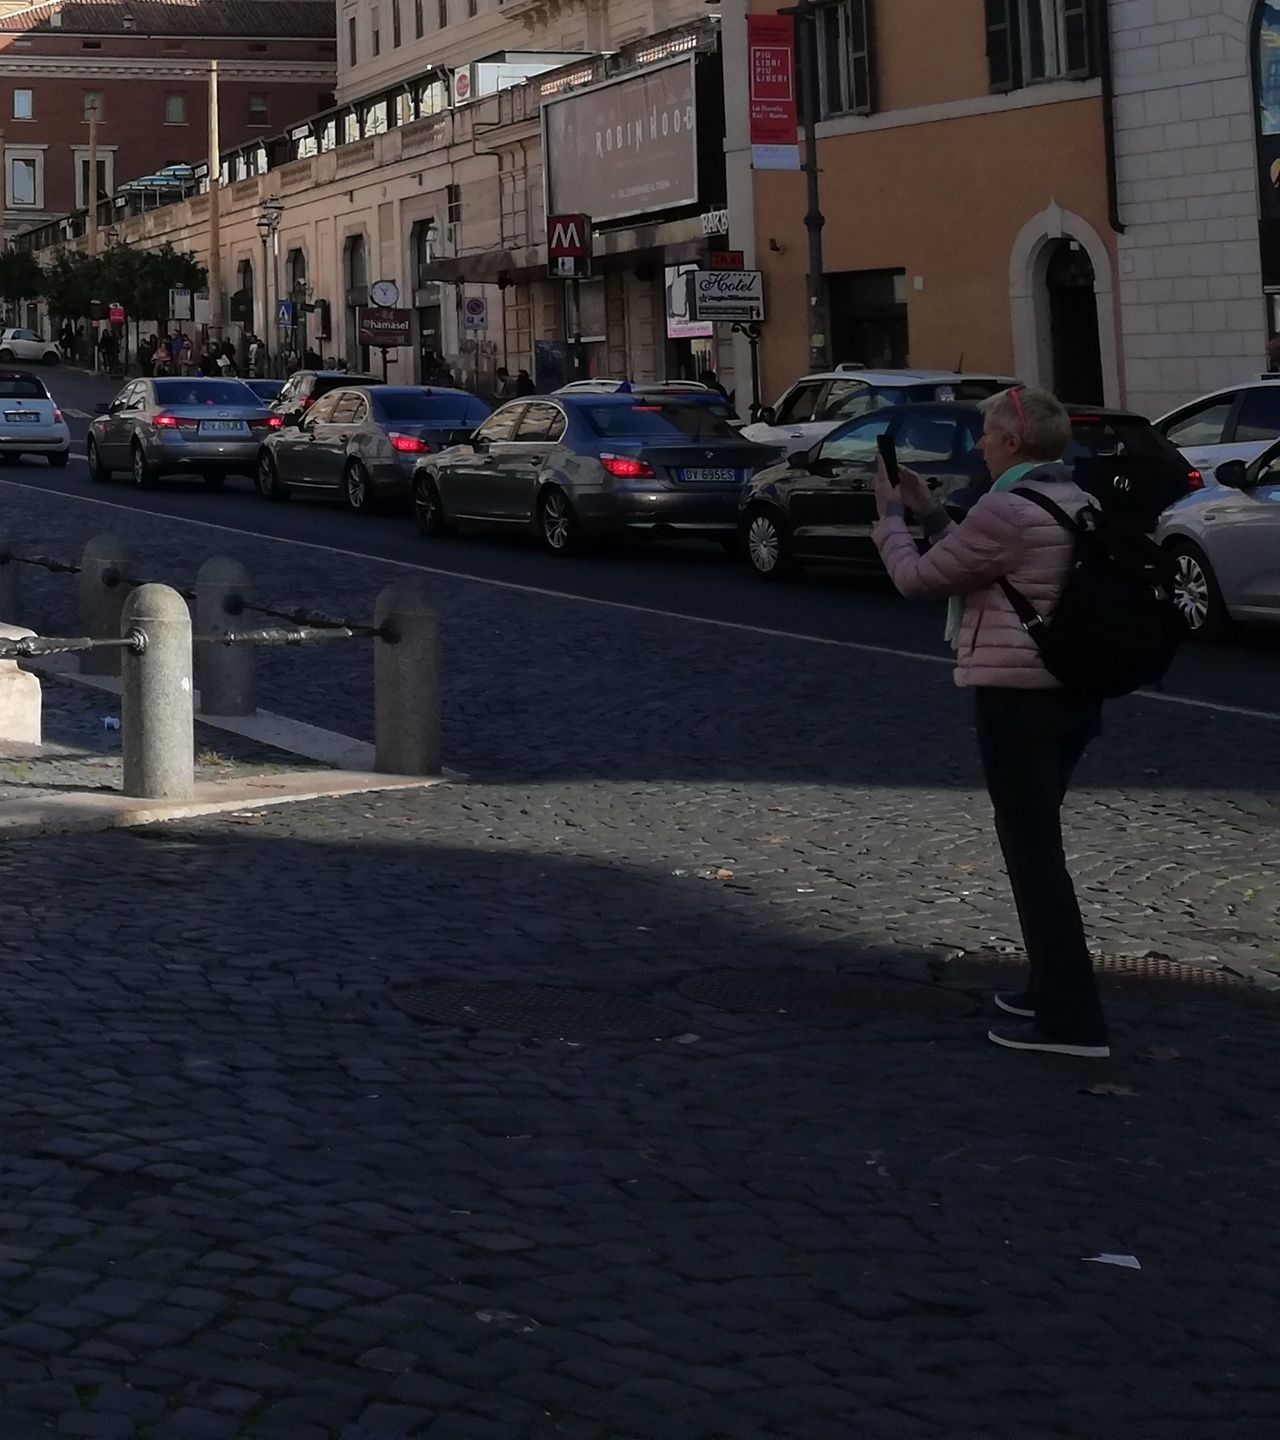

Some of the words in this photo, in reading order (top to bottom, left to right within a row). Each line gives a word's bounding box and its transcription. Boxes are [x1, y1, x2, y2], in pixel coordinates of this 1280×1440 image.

[595, 120, 643, 159] ROBIN
[649, 105, 694, 140] HOOD
[551, 222, 581, 249] M
[700, 273, 757, 293] Hotel
